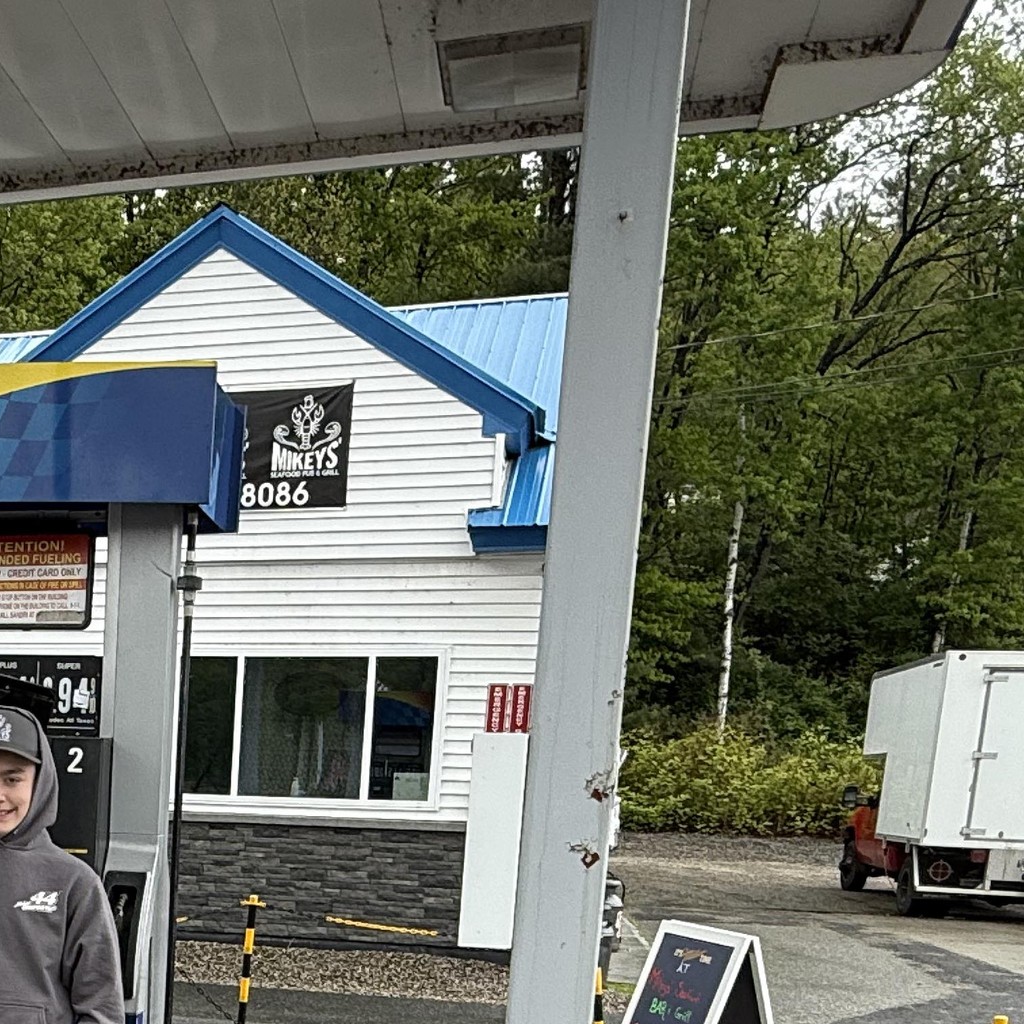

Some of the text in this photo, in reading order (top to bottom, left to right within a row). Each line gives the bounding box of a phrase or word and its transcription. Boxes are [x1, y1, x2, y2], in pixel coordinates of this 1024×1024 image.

[270, 471, 301, 479] SEAFOOD
[321, 469, 340, 477] GRILL
[240, 481, 309, 508] 8086
[32, 552, 81, 565] FUELING
[7, 568, 36, 578] CREDIT
[37, 568, 59, 577] CARD
[61, 567, 82, 577] ONLY
[0, 661, 17, 669] PLUS
[57, 662, 81, 670] SUPER
[67, 747, 84, 773] 2
